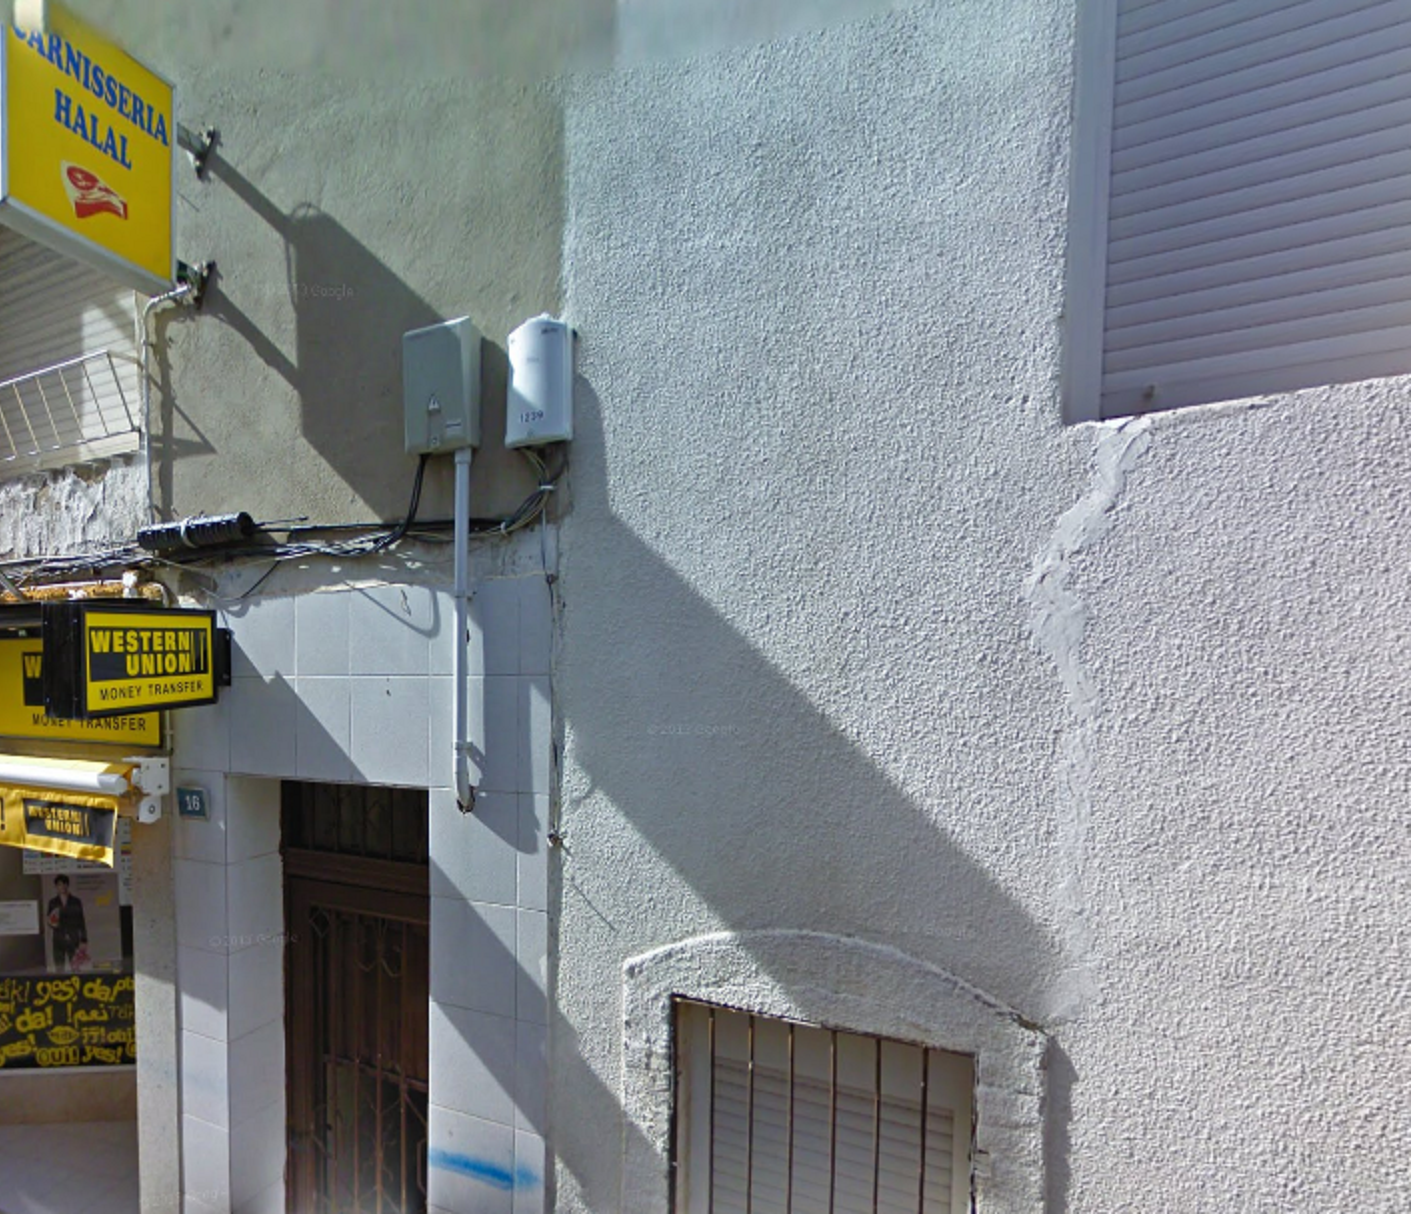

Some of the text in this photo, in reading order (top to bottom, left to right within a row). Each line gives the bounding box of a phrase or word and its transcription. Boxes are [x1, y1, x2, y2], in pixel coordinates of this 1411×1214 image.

[54, 88, 132, 170] HALAL
[90, 629, 190, 653] WESTERN
[126, 653, 191, 676] UNION
[100, 680, 204, 701] MONEY TRANSFER
[28, 805, 82, 822] WESTERN
[186, 795, 201, 812] 16
[45, 819, 82, 836] UNION
